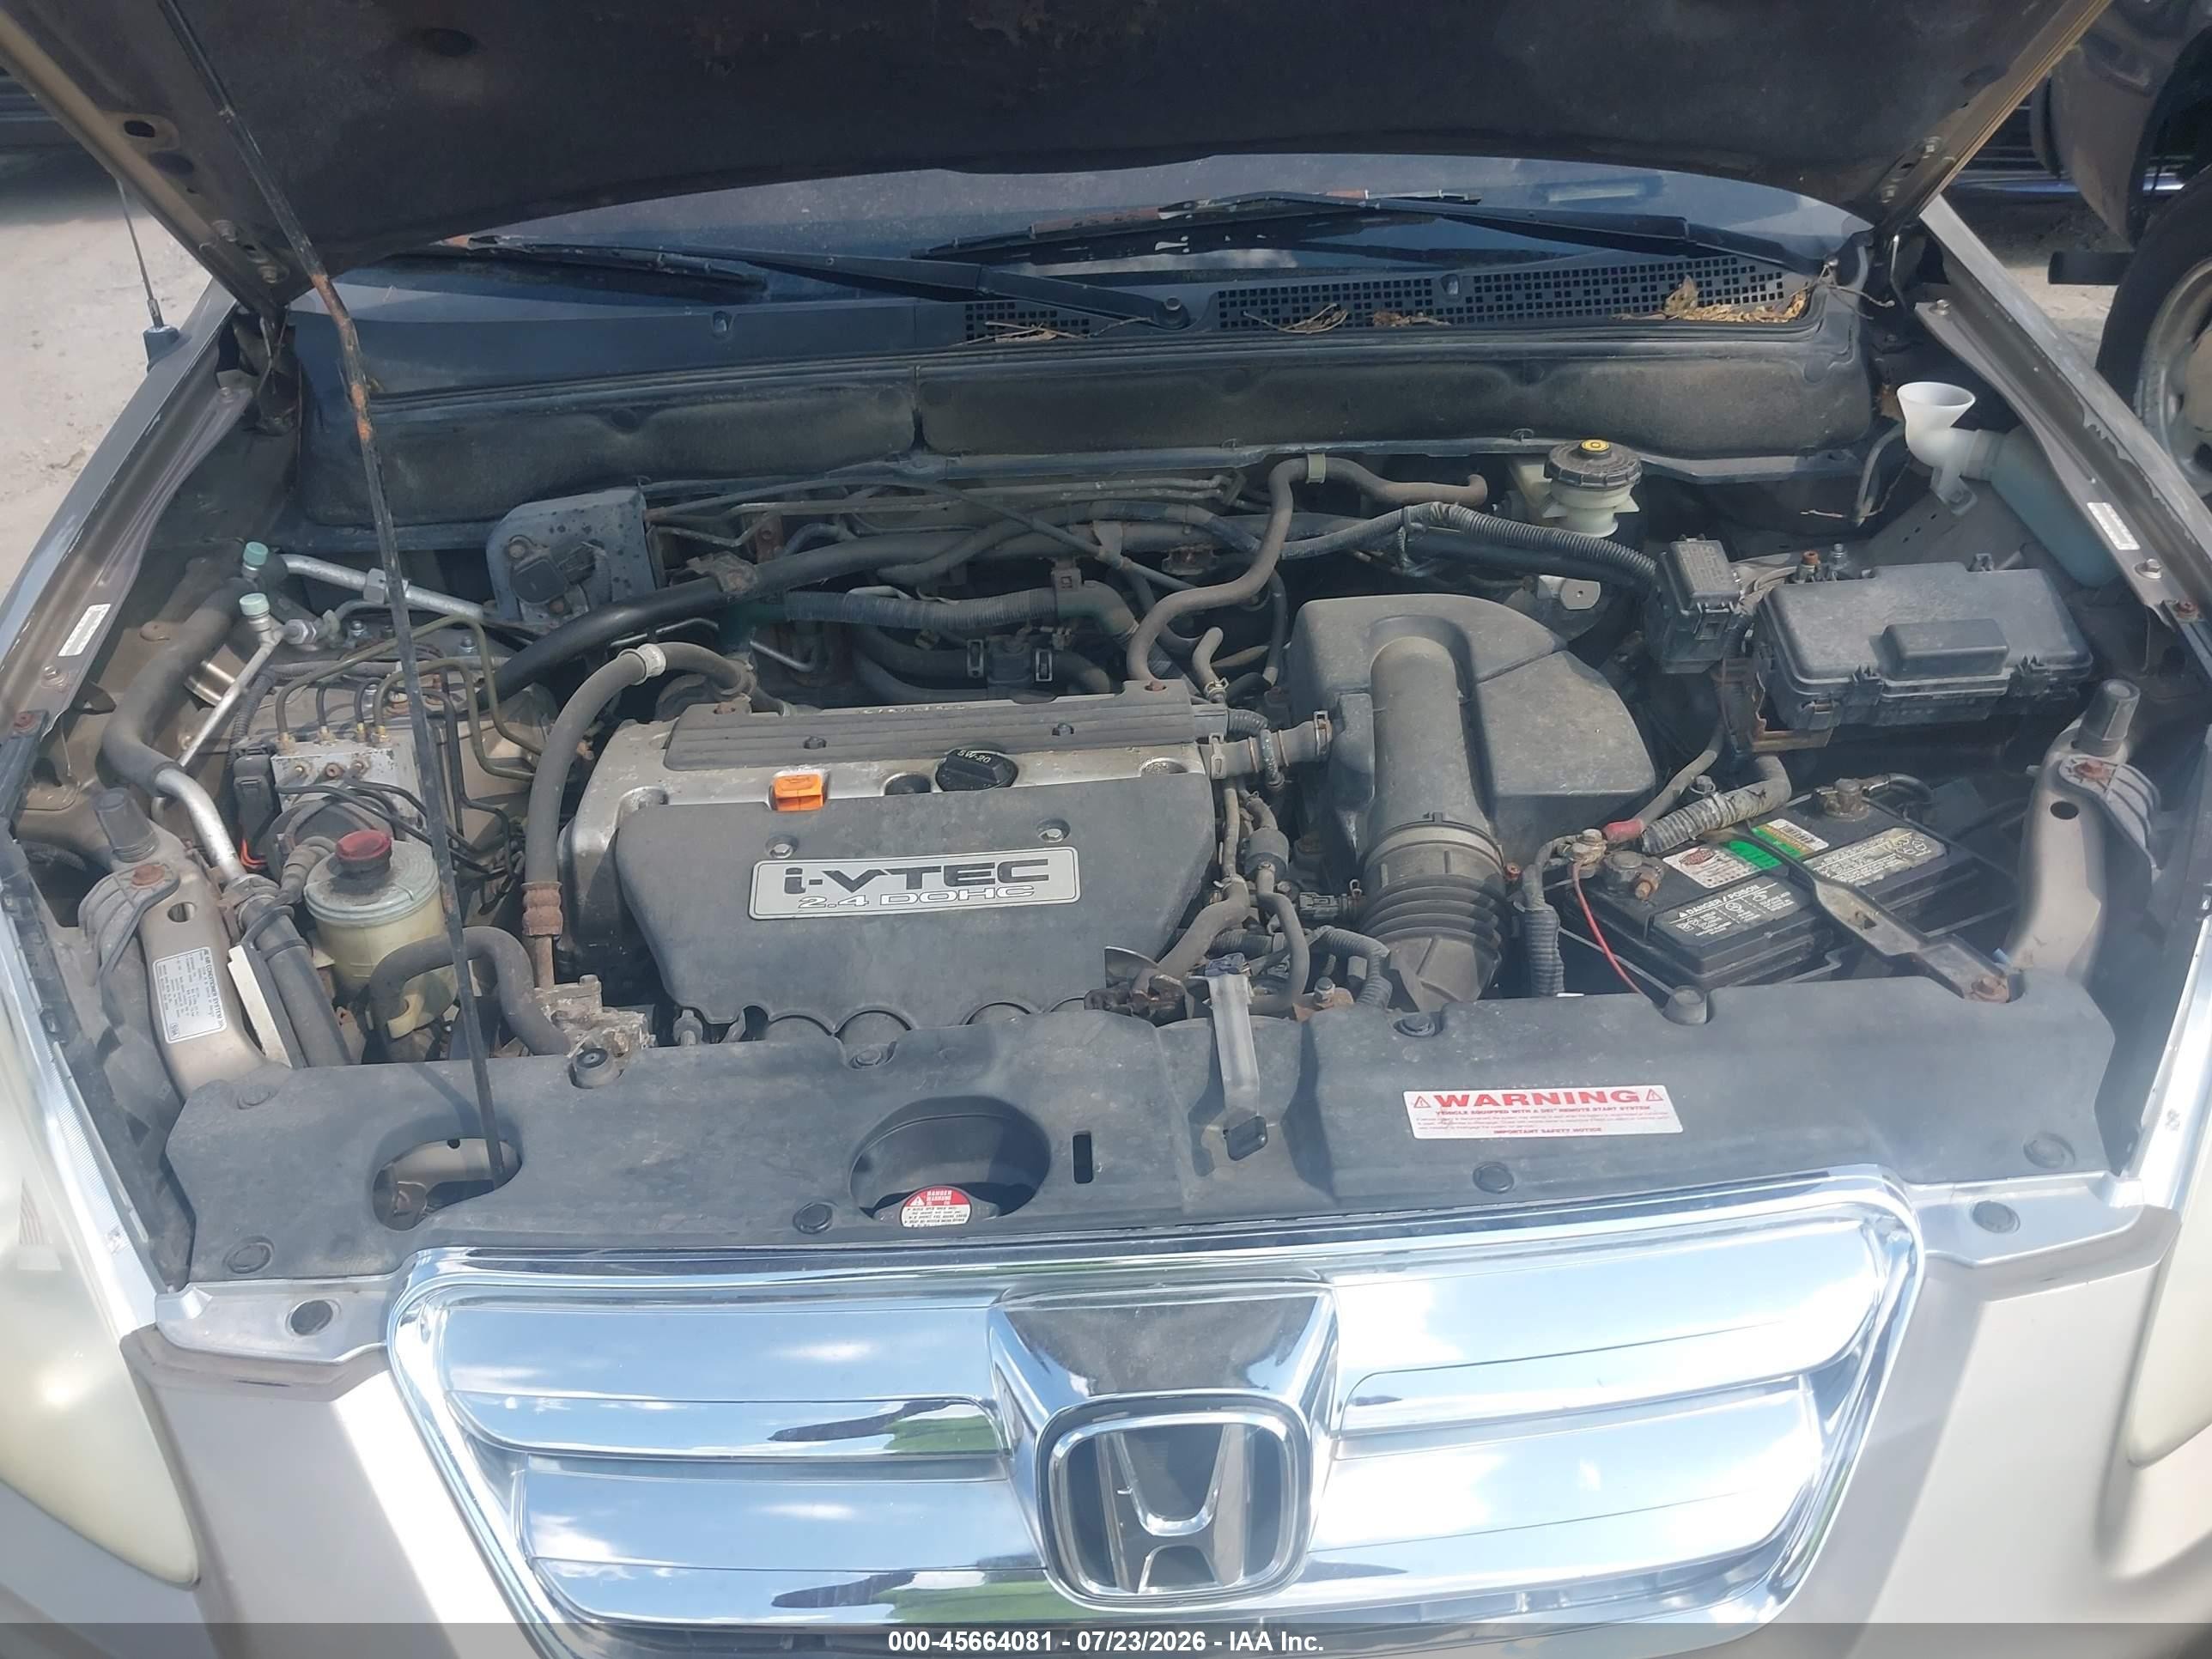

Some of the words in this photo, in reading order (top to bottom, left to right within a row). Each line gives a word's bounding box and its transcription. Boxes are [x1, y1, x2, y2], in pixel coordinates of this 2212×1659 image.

[957, 750, 992, 764] 5W-20
[784, 859, 1049, 895] i-VTEC
[798, 894, 869, 909] 2.4
[879, 885, 1035, 906] DOHC
[1686, 898, 1720, 915] DANGER
[1728, 884, 1760, 899] POISON
[213, 998, 222, 1018] SYSTEM
[1434, 1090, 1641, 1108] WARNING
